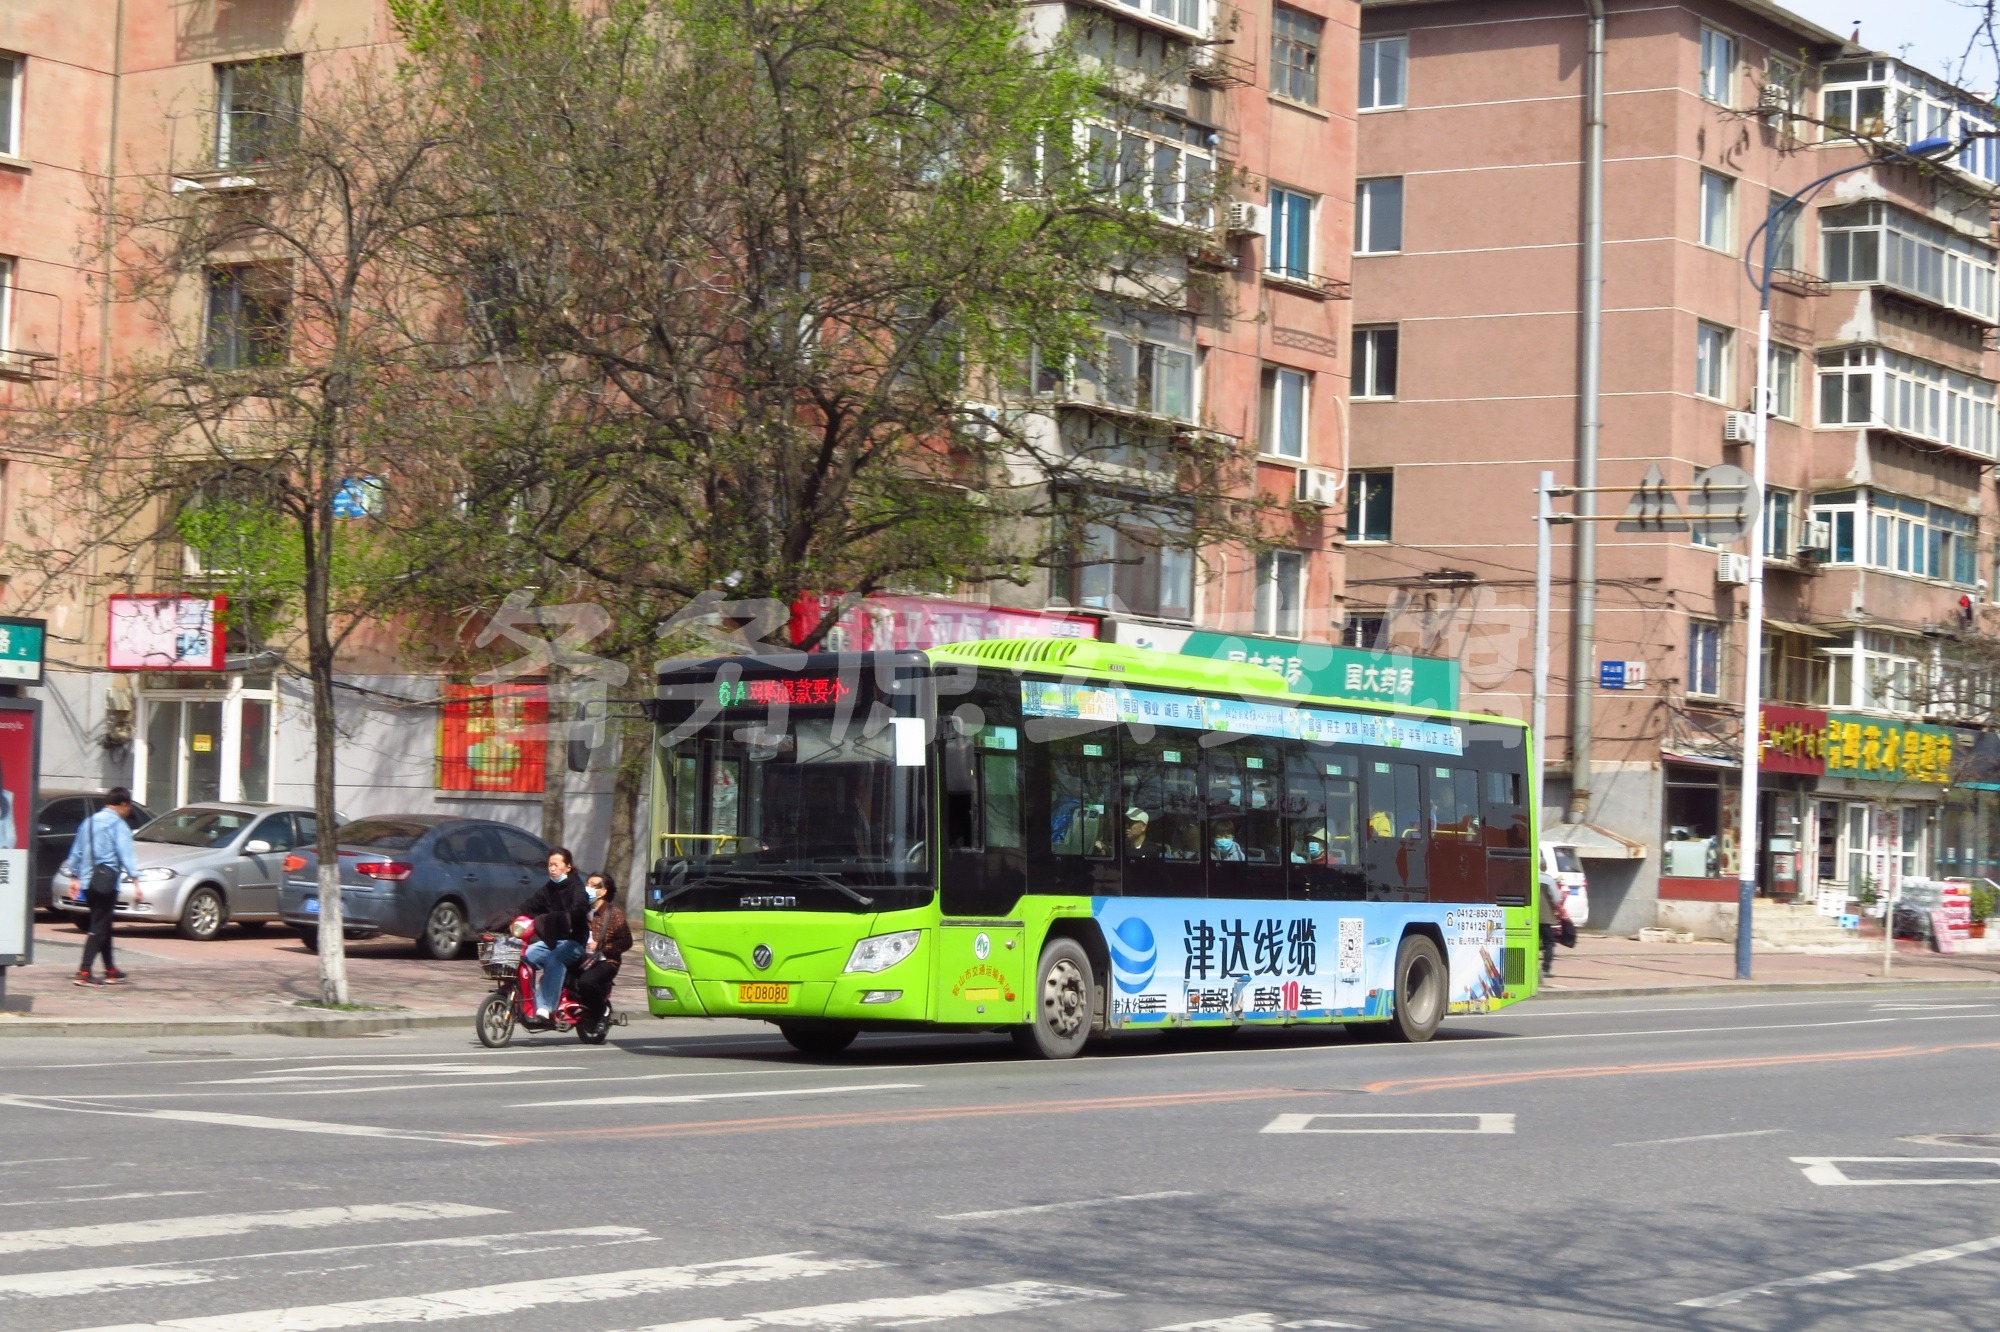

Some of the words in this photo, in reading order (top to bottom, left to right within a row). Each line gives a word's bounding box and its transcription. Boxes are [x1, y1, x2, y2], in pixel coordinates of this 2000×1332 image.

[1345, 663, 1415, 695] 国大药房
[1123, 698, 1139, 714] 爱国
[1144, 700, 1159, 716] 敬业
[1164, 702, 1179, 718] 诚信
[1186, 705, 1201, 720] 友善
[1308, 718, 1322, 732] 富强
[1327, 719, 1341, 733] 民主
[1345, 721, 1359, 735] 文明
[1362, 723, 1376, 737] 和谐
[1409, 728, 1421, 742] 平等
[1426, 731, 1438, 745] 公正
[740, 896, 796, 907] FOTON
[1184, 918, 1317, 980] 津达线缆
